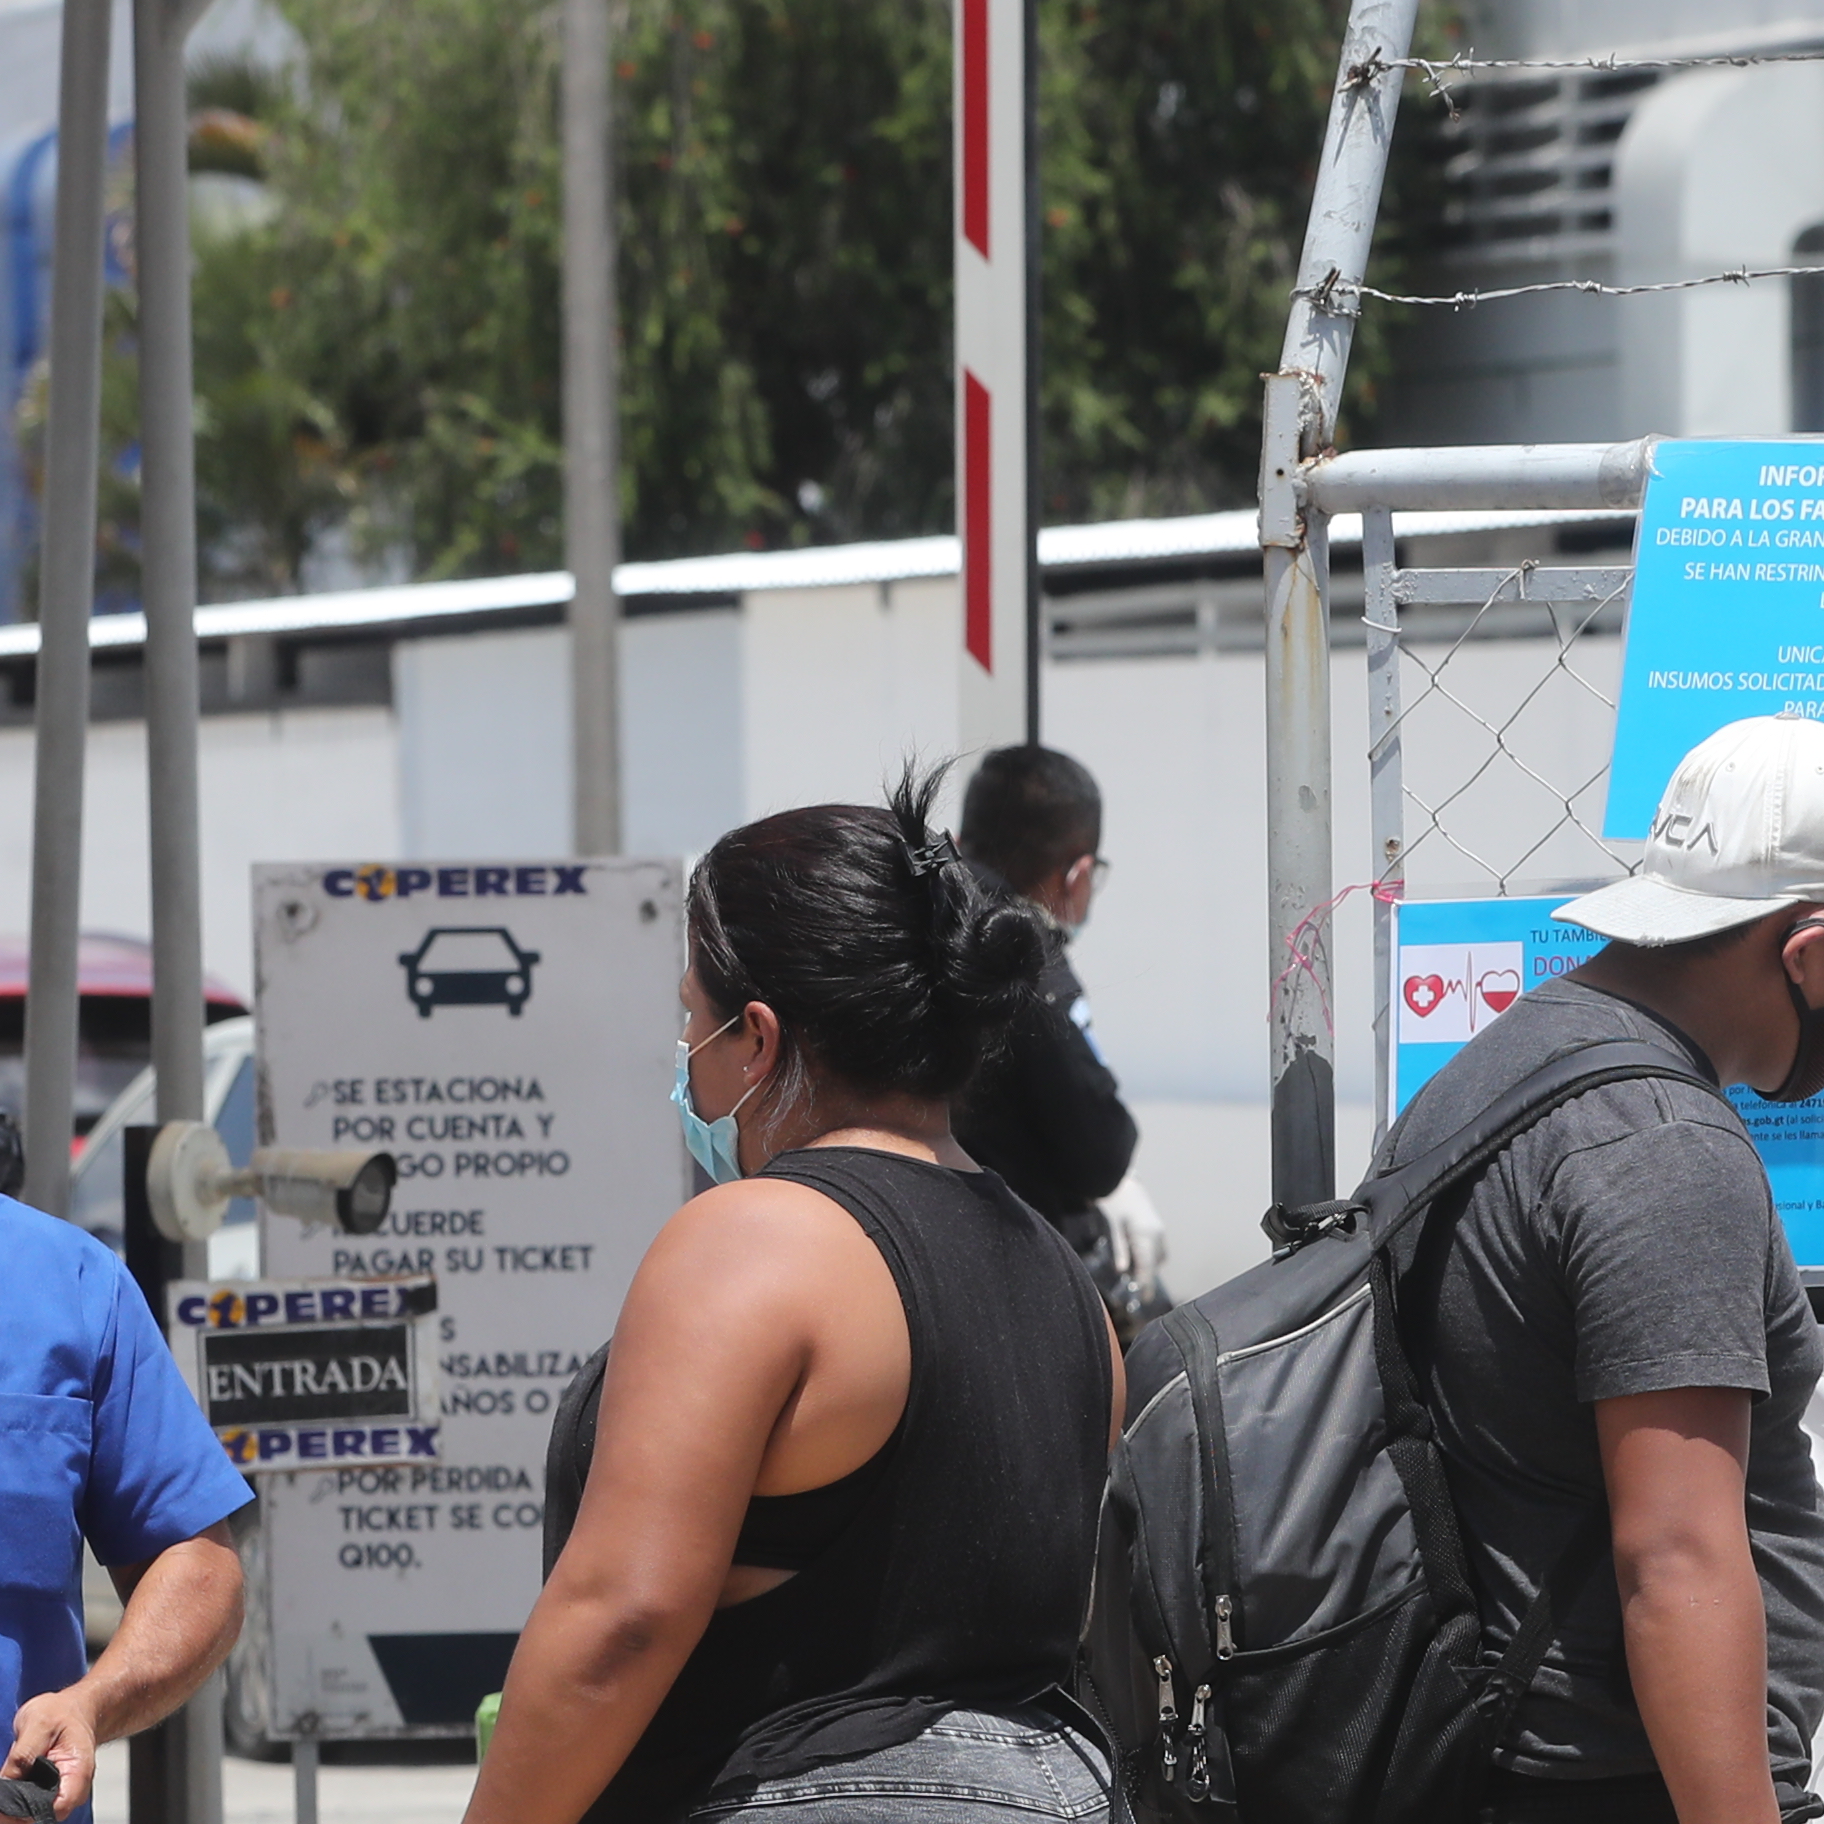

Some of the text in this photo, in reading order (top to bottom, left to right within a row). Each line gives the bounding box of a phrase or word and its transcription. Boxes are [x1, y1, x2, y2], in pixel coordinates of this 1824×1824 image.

[1680, 497, 1743, 520] PARA
[1749, 498, 1794, 521] LOS
[1656, 527, 1727, 547] DEBIDO
[1730, 530, 1744, 547] A
[1747, 530, 1771, 548] LA
[1684, 562, 1706, 581] SE
[1709, 562, 1751, 581] HAN
[1648, 671, 1733, 691] INSUMOS
[1530, 929, 1549, 944] TU
[333, 1077, 545, 1105] SE ESTACIONA
[333, 1112, 555, 1142] POR CUENTA Y
[455, 1150, 571, 1178] PROPIO
[333, 1245, 594, 1275] PAGAR SU TICKET
[208, 1354, 408, 1403] ENTRADA
[338, 1465, 532, 1495] POR PERDIDA
[338, 1504, 440, 1532] TICKET
[450, 1504, 482, 1530] SE
[338, 1542, 423, 1569] Q100.
